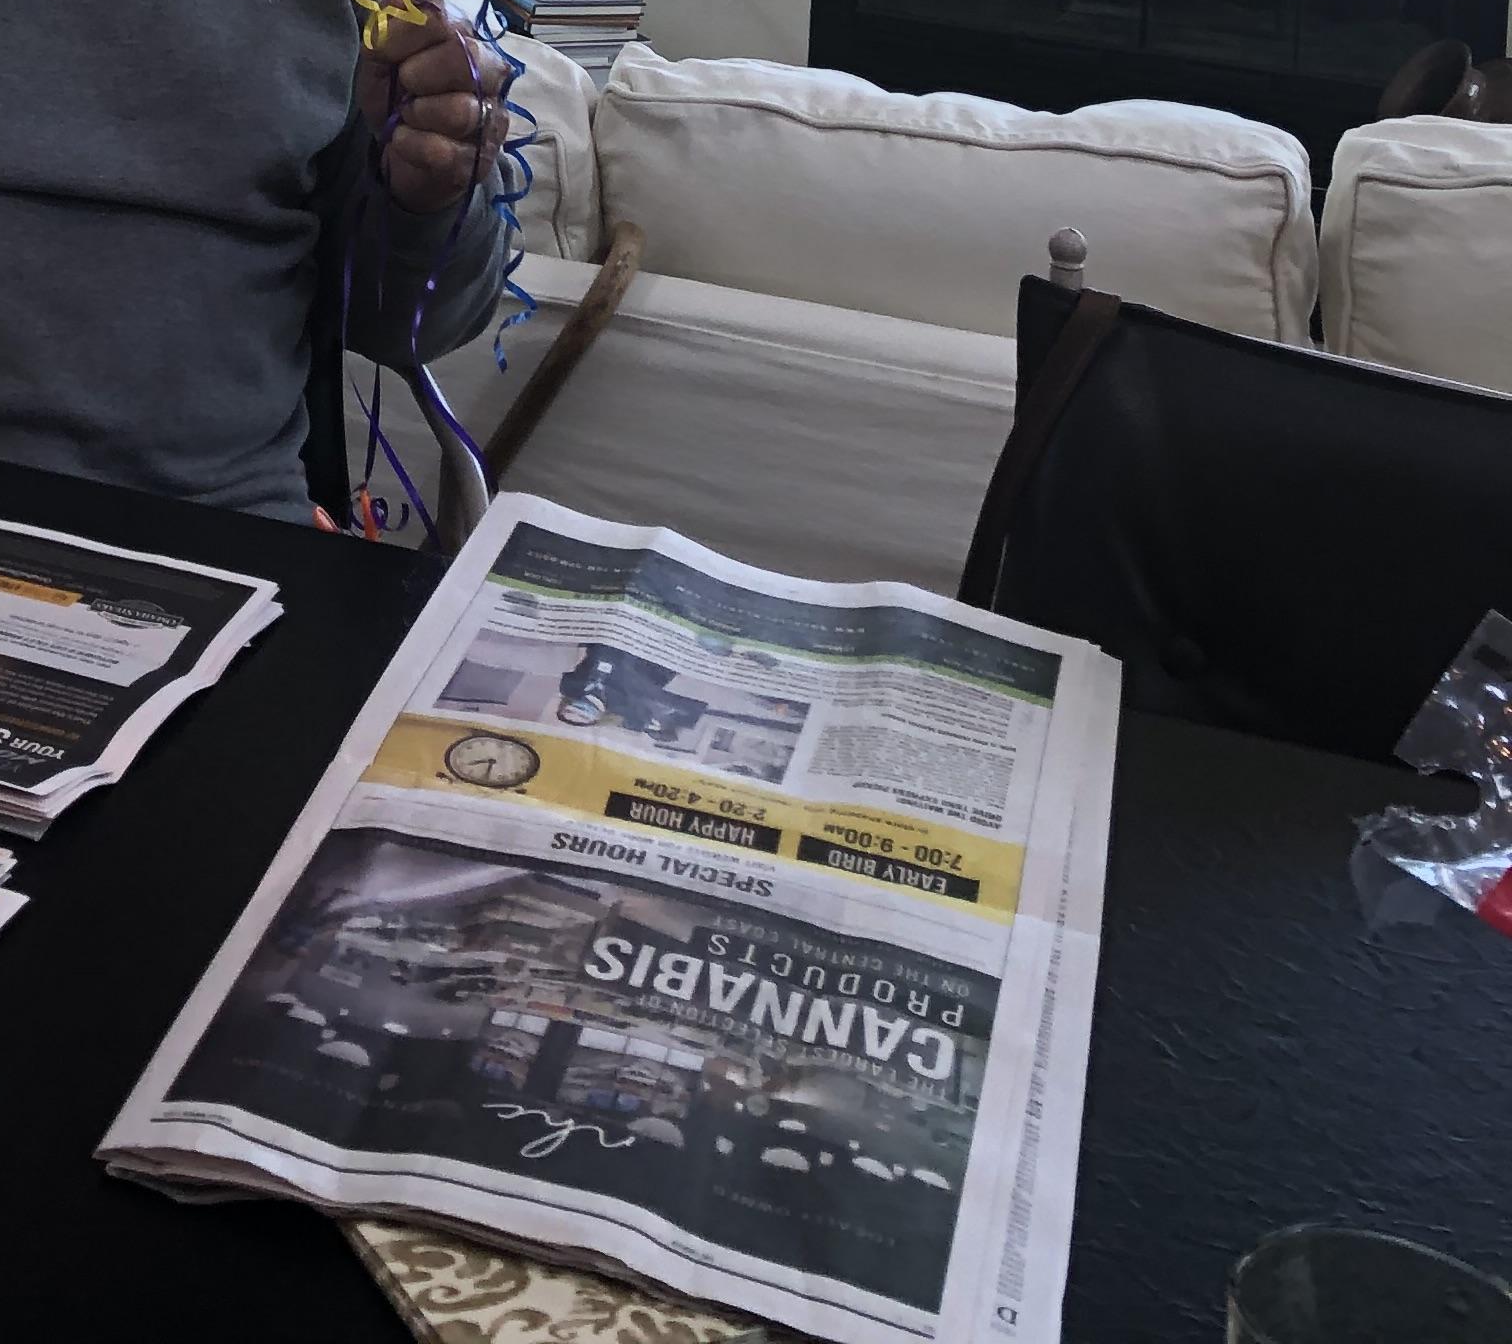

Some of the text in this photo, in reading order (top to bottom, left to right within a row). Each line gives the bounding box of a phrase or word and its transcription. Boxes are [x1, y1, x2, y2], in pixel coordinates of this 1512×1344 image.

[11, 737, 65, 760] YOUR
[630, 801, 683, 829] HOUR
[688, 816, 754, 846] HAPPY
[549, 832, 774, 897] SPECIAL HOURS
[828, 849, 947, 894] EARLY BIRD
[914, 845, 963, 871] 7:00
[792, 937, 881, 973] CENTRAL
[707, 933, 964, 1027] PRODUCTS
[585, 936, 956, 1081] CANNABIS
